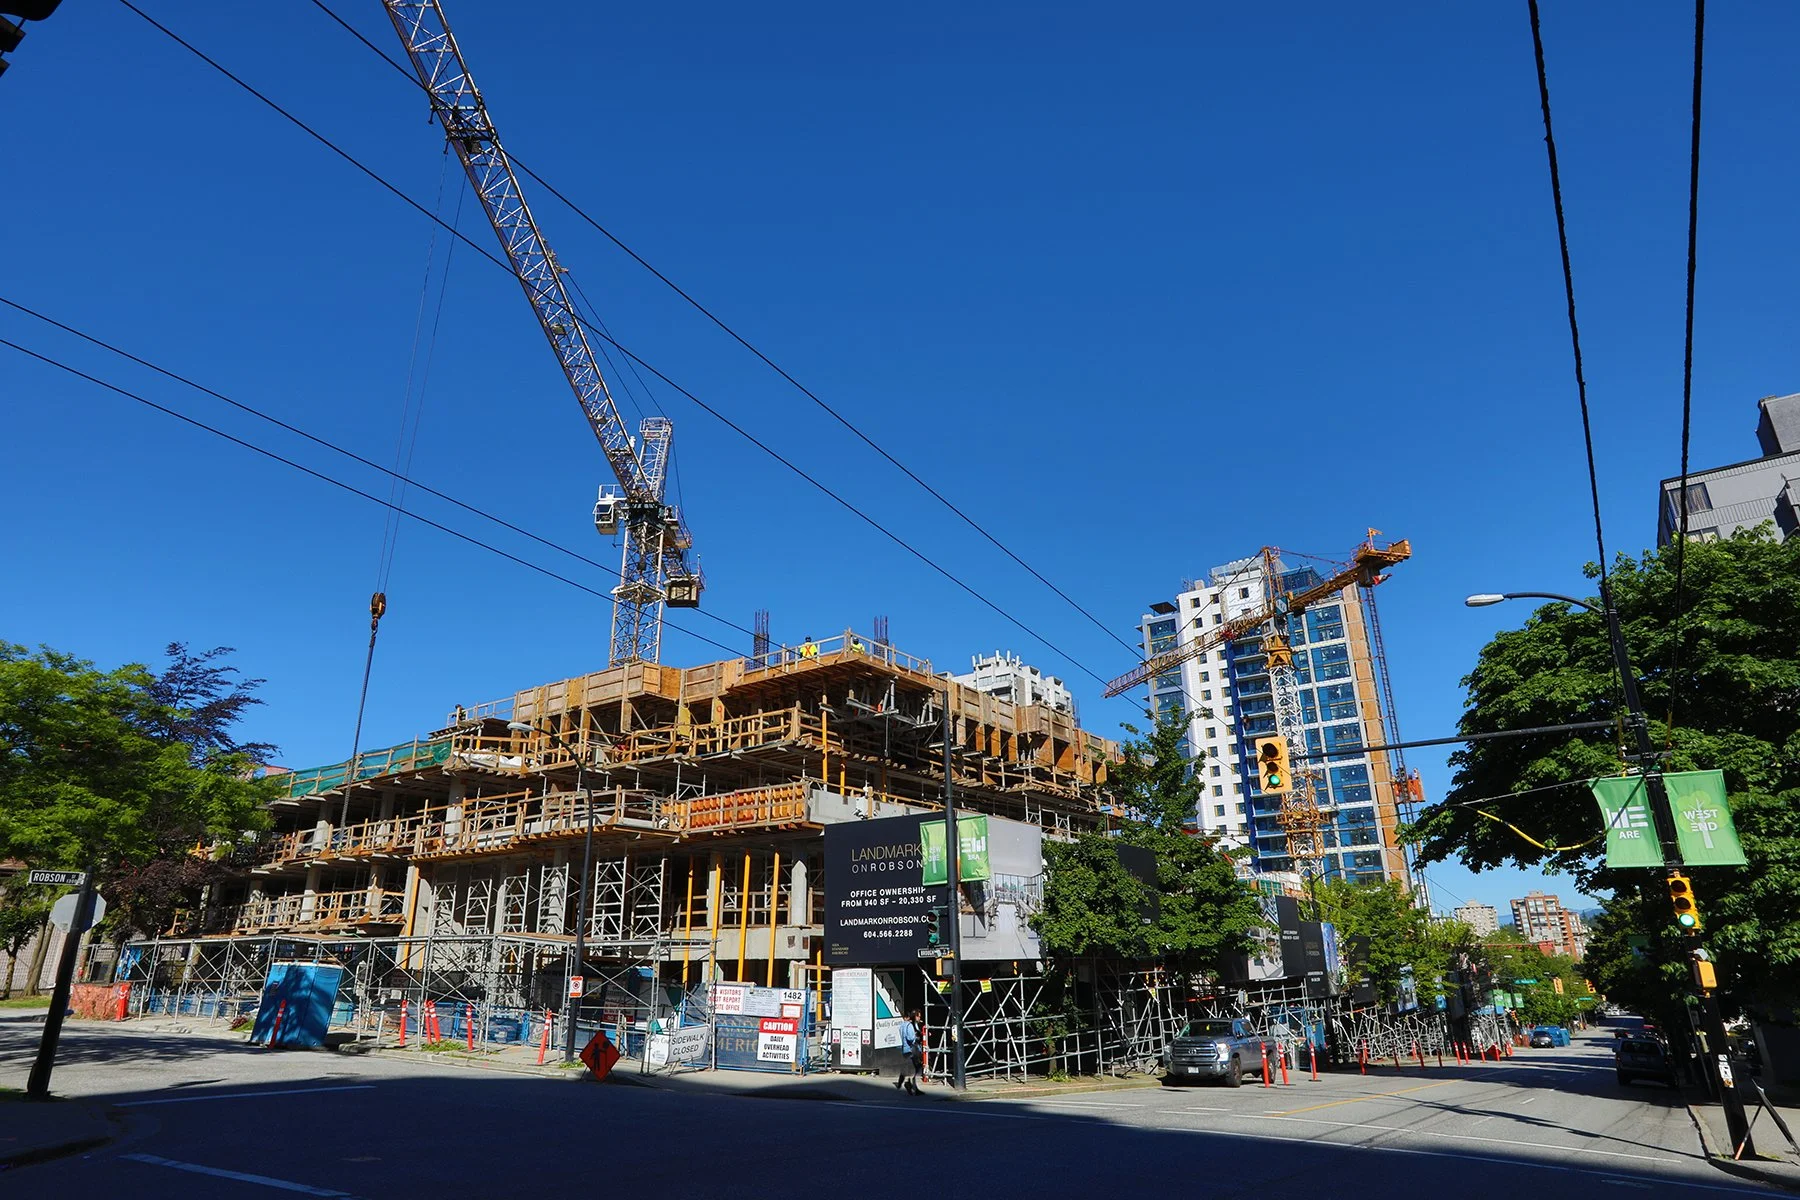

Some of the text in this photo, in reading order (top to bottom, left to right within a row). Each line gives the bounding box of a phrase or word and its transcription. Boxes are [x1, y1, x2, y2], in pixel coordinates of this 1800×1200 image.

[1605, 805, 1648, 829] WE
[1682, 808, 1718, 819] WEST
[1691, 822, 1718, 832] END
[1619, 830, 1640, 840] ARE
[851, 843, 923, 861] LANDMARK
[33, 873, 66, 882] ROBSON
[850, 886, 926, 898] OFFICE OWNERSHIP
[841, 900, 862, 908] FROM
[864, 898, 877, 906] 940
[880, 897, 889, 905] SF
[898, 896, 924, 905] 20,330
[926, 895, 937, 903] SF
[840, 915, 930, 926] LANDMARKONROBSON.C
[863, 929, 913, 938] 604.566.2288
[783, 991, 802, 1000] 1482
[763, 1021, 794, 1032] CAUTION
[671, 1033, 705, 1046] SIDEWALK
[673, 1044, 699, 1055] CLOSED
[763, 1043, 789, 1051] OVERHEAD
